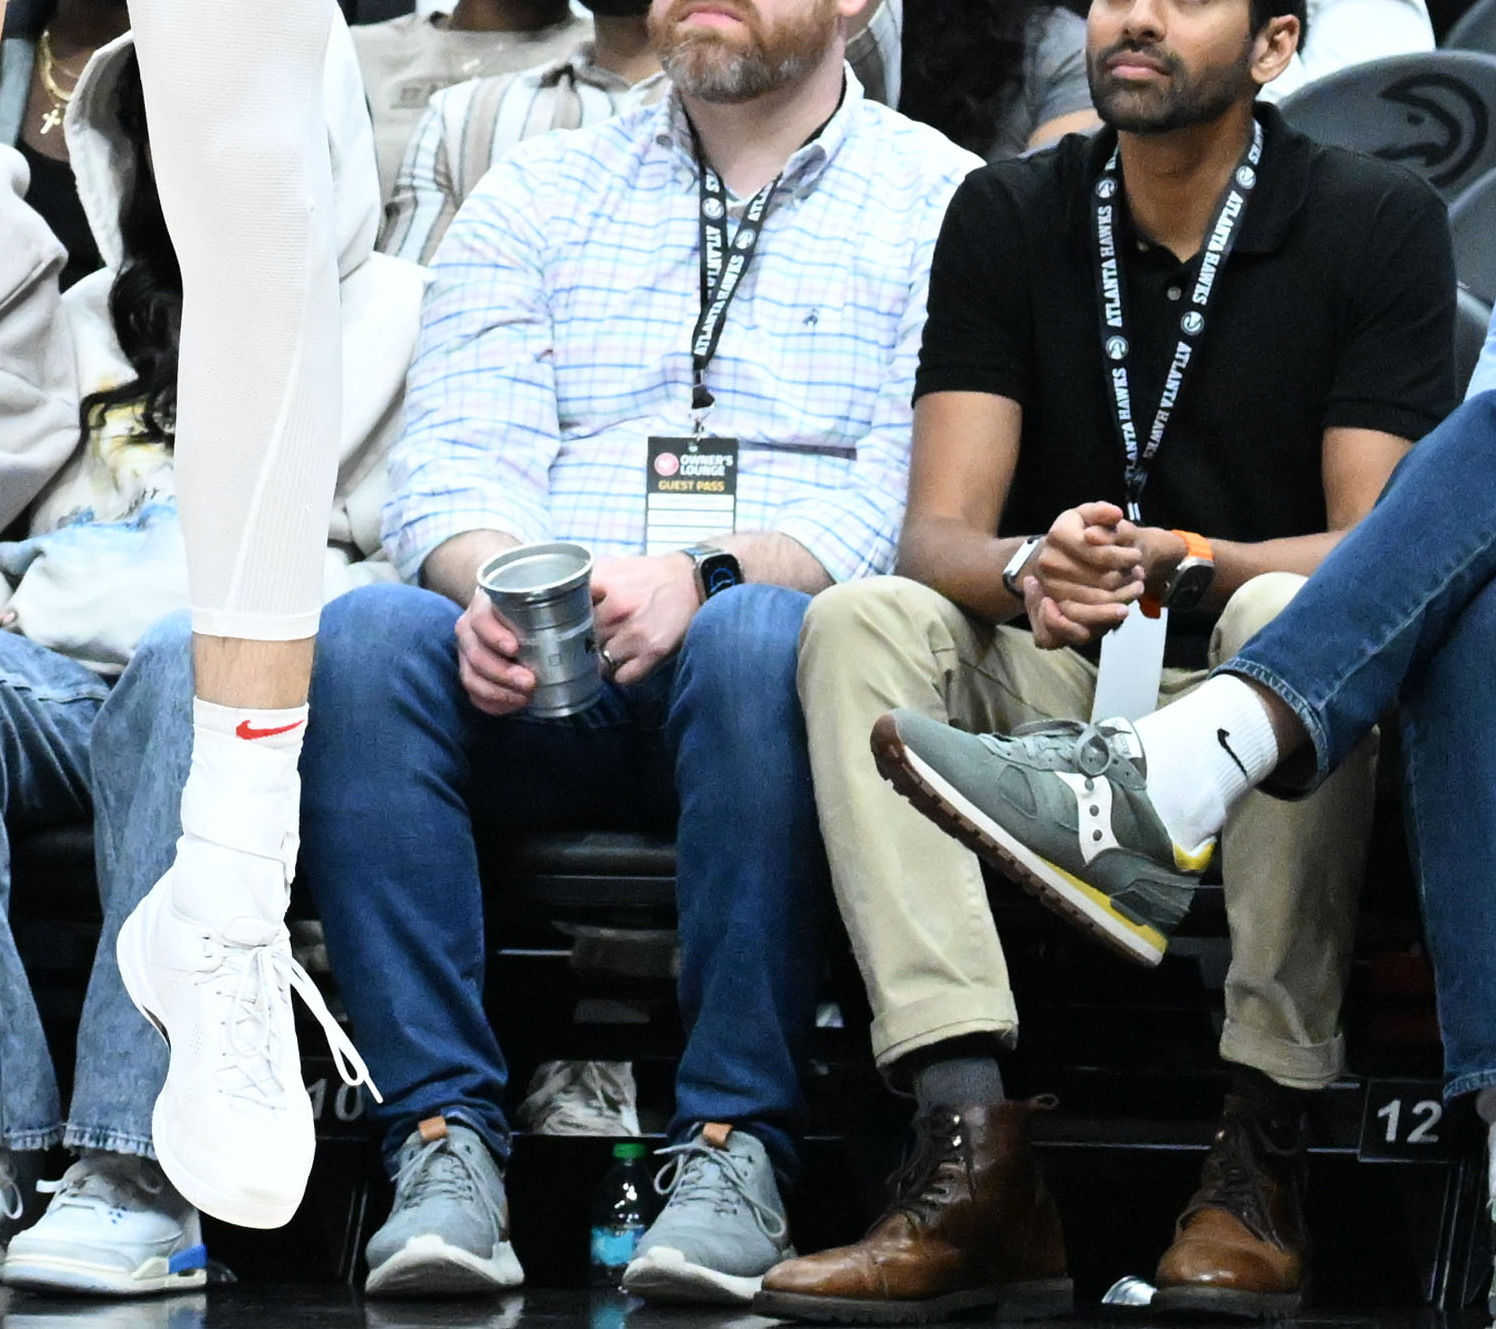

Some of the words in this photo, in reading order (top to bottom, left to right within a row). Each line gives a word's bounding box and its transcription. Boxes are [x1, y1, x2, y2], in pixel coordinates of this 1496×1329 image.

[1097, 205, 1117, 257] HAWKS
[1208, 190, 1244, 256] ATLANTA
[1102, 258, 1122, 328] ATLANTA
[1192, 250, 1221, 306] HAWKS
[693, 299, 727, 357] ATLANTA
[1111, 367, 1131, 427] HAWKS
[1159, 340, 1193, 410] ATLANTA
[658, 480, 695, 491] GUEST
[696, 480, 725, 492] PASS
[680, 454, 734, 467] OWNER'S
[680, 465, 726, 477] LOUNGE
[306, 1078, 365, 1121] 10
[1376, 1099, 1443, 1143] 12
